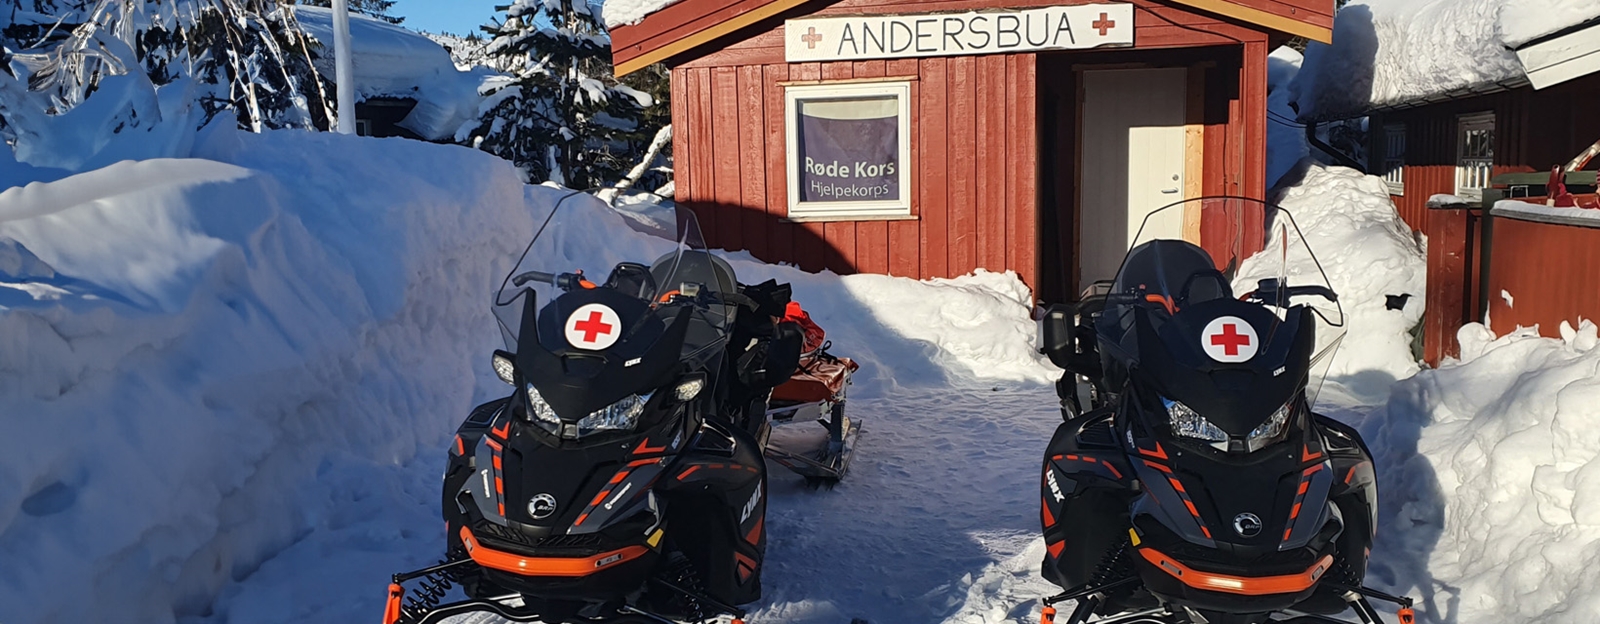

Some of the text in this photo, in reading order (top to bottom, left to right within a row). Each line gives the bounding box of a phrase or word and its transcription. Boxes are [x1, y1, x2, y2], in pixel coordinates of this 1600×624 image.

[837, 12, 1075, 55] ANDERSBUA
[805, 156, 895, 178] Røde Kors
[811, 180, 889, 199] Hjelpekorps
[740, 478, 762, 524] LYNX
[1046, 469, 1066, 503] LYNX
